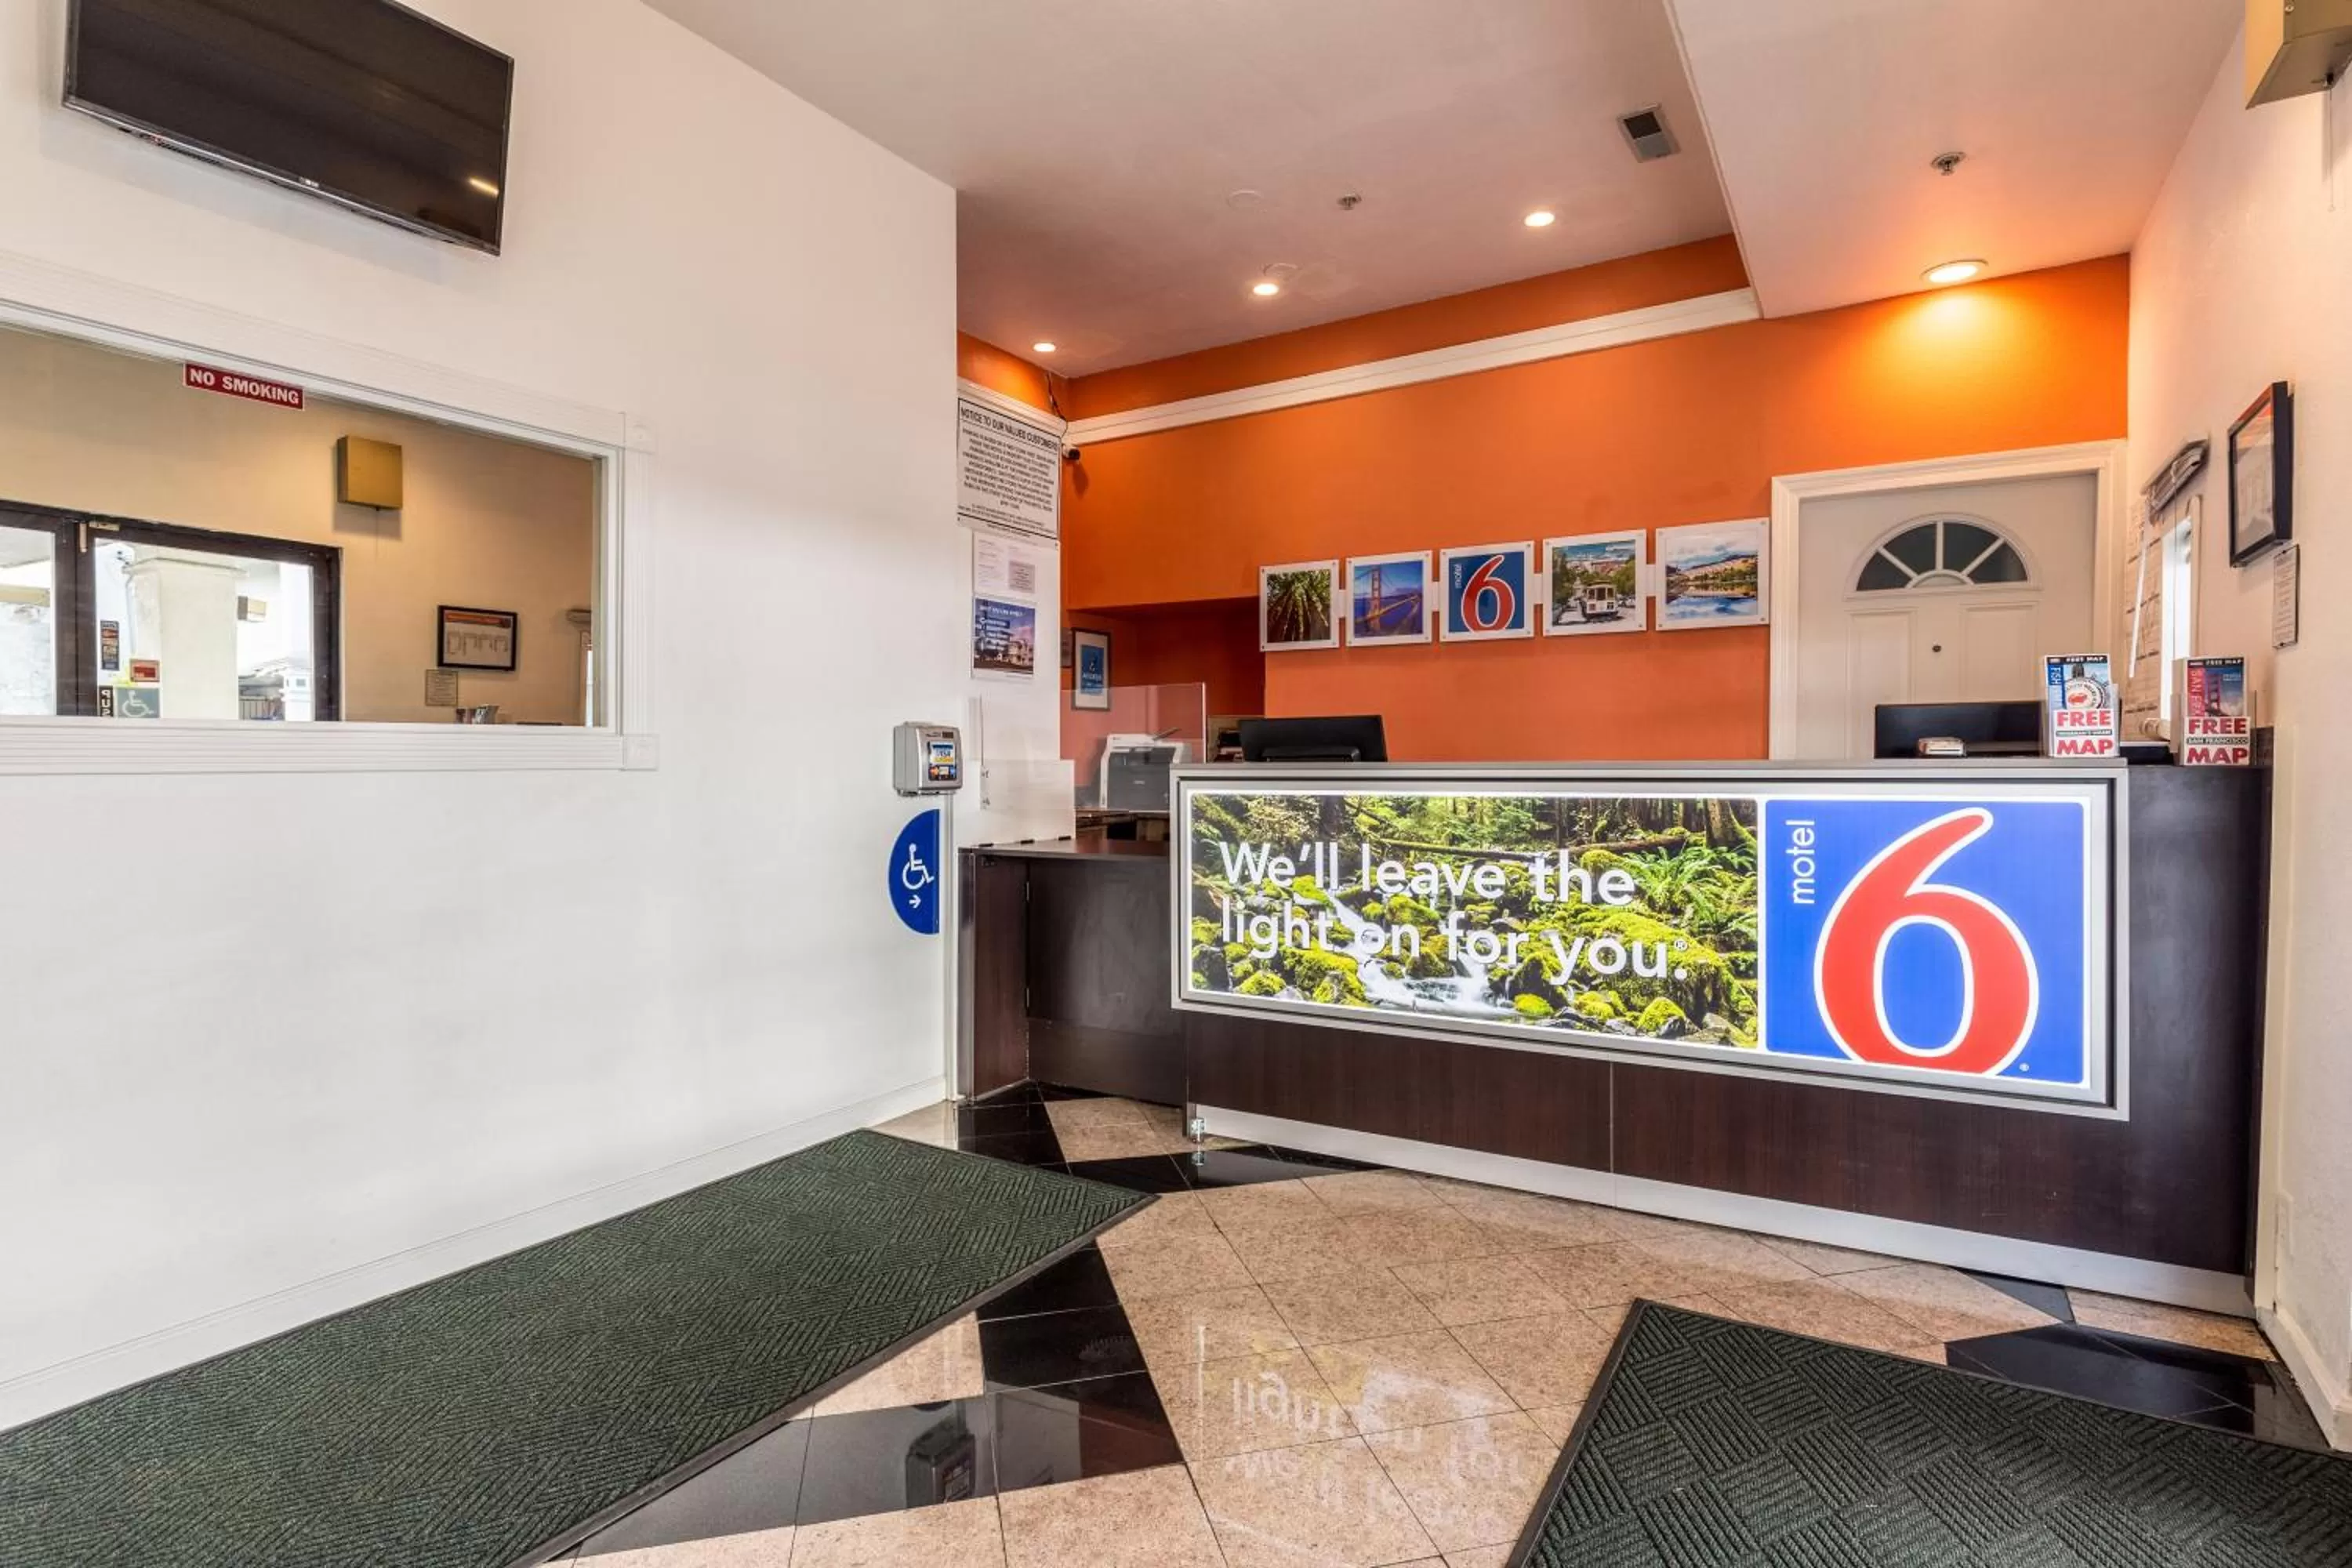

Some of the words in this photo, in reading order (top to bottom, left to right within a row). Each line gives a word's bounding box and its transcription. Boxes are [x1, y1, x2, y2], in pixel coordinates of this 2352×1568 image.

[190, 368, 216, 386] NO
[222, 376, 299, 405] SMOKING
[960, 407, 982, 424] NOTICE
[1461, 554, 1515, 633] 6
[2056, 710, 2111, 727] FREE
[2188, 717, 2247, 735] FREE
[2056, 739, 2113, 754] MAP
[2187, 747, 2248, 764] MAP
[1220, 841, 1339, 889] We’ll
[1362, 843, 1506, 898] leave
[1530, 848, 1635, 906] the
[1785, 819, 1815, 904] motel
[1222, 896, 1335, 960] light
[1355, 920, 1421, 958] on
[1439, 909, 1530, 967] for
[1813, 807, 2039, 1077] 6
